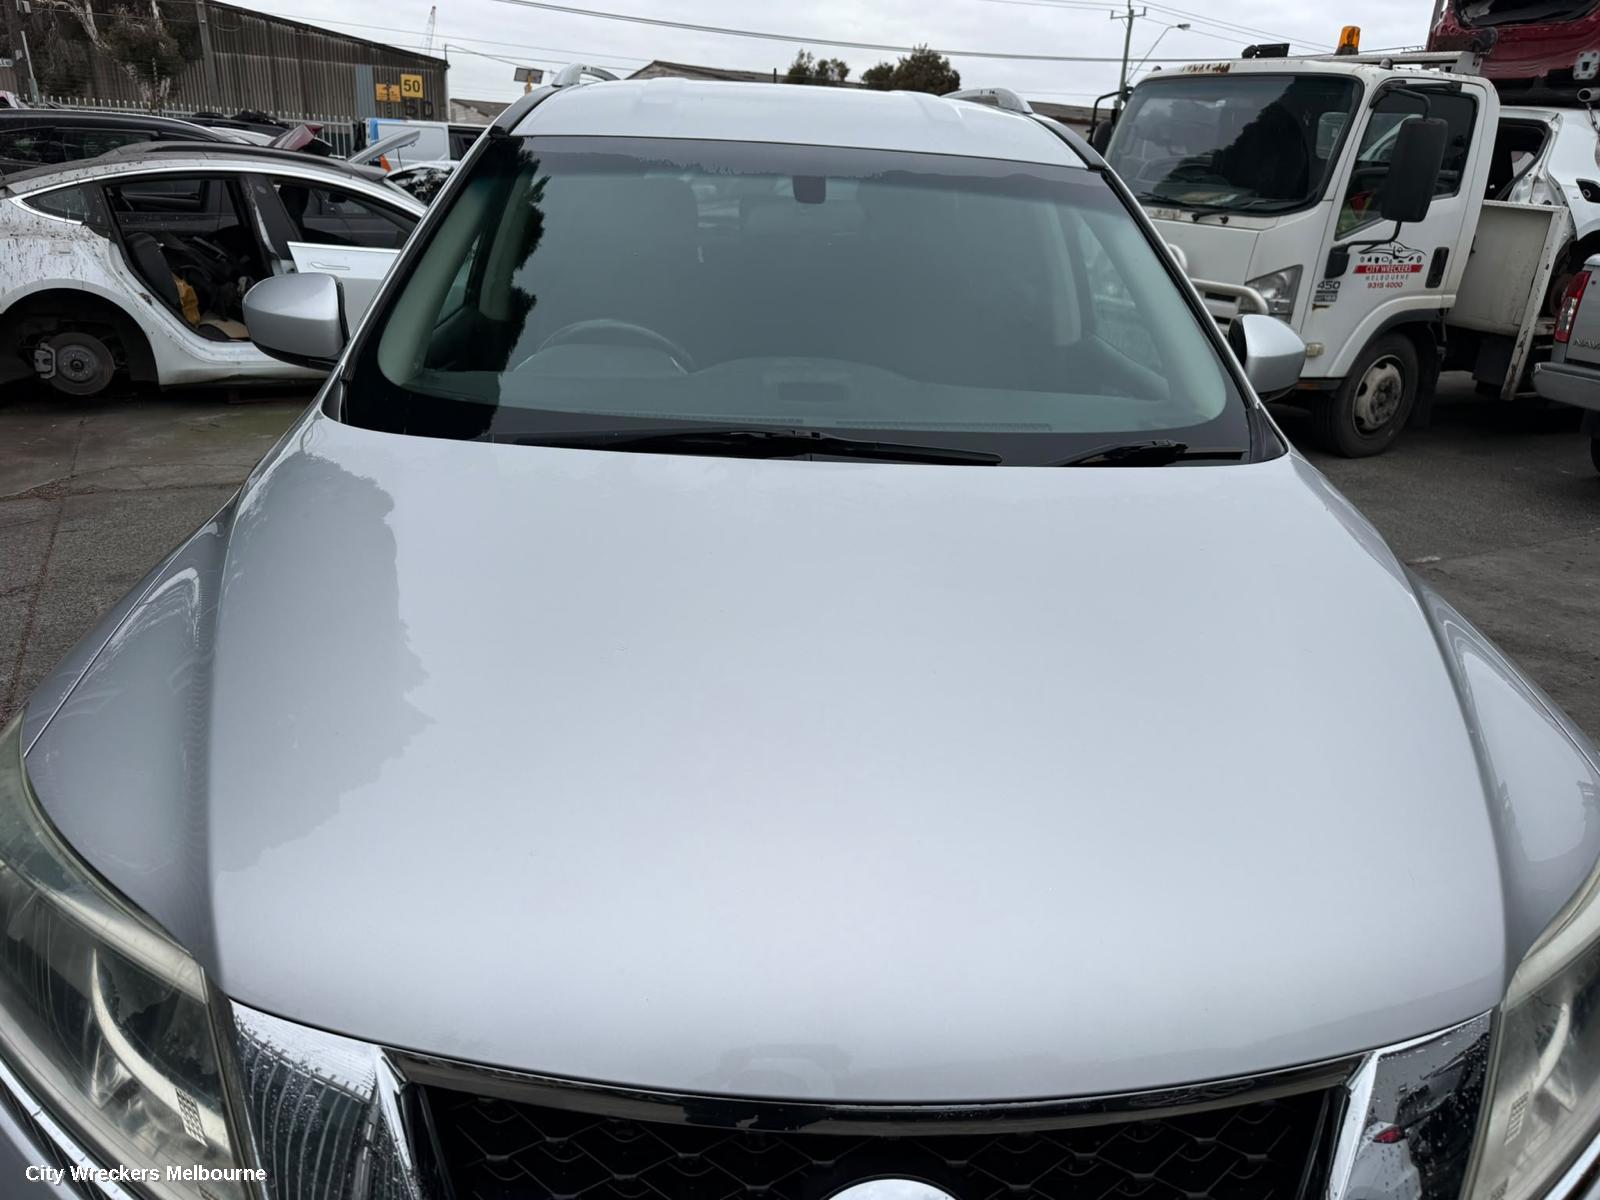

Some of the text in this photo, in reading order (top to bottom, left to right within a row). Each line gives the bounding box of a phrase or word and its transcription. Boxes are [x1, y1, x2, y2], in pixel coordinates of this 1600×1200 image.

[403, 79, 421, 93] 50
[1365, 264, 1412, 273] CITY WRECKERS
[1317, 280, 1341, 289] 450
